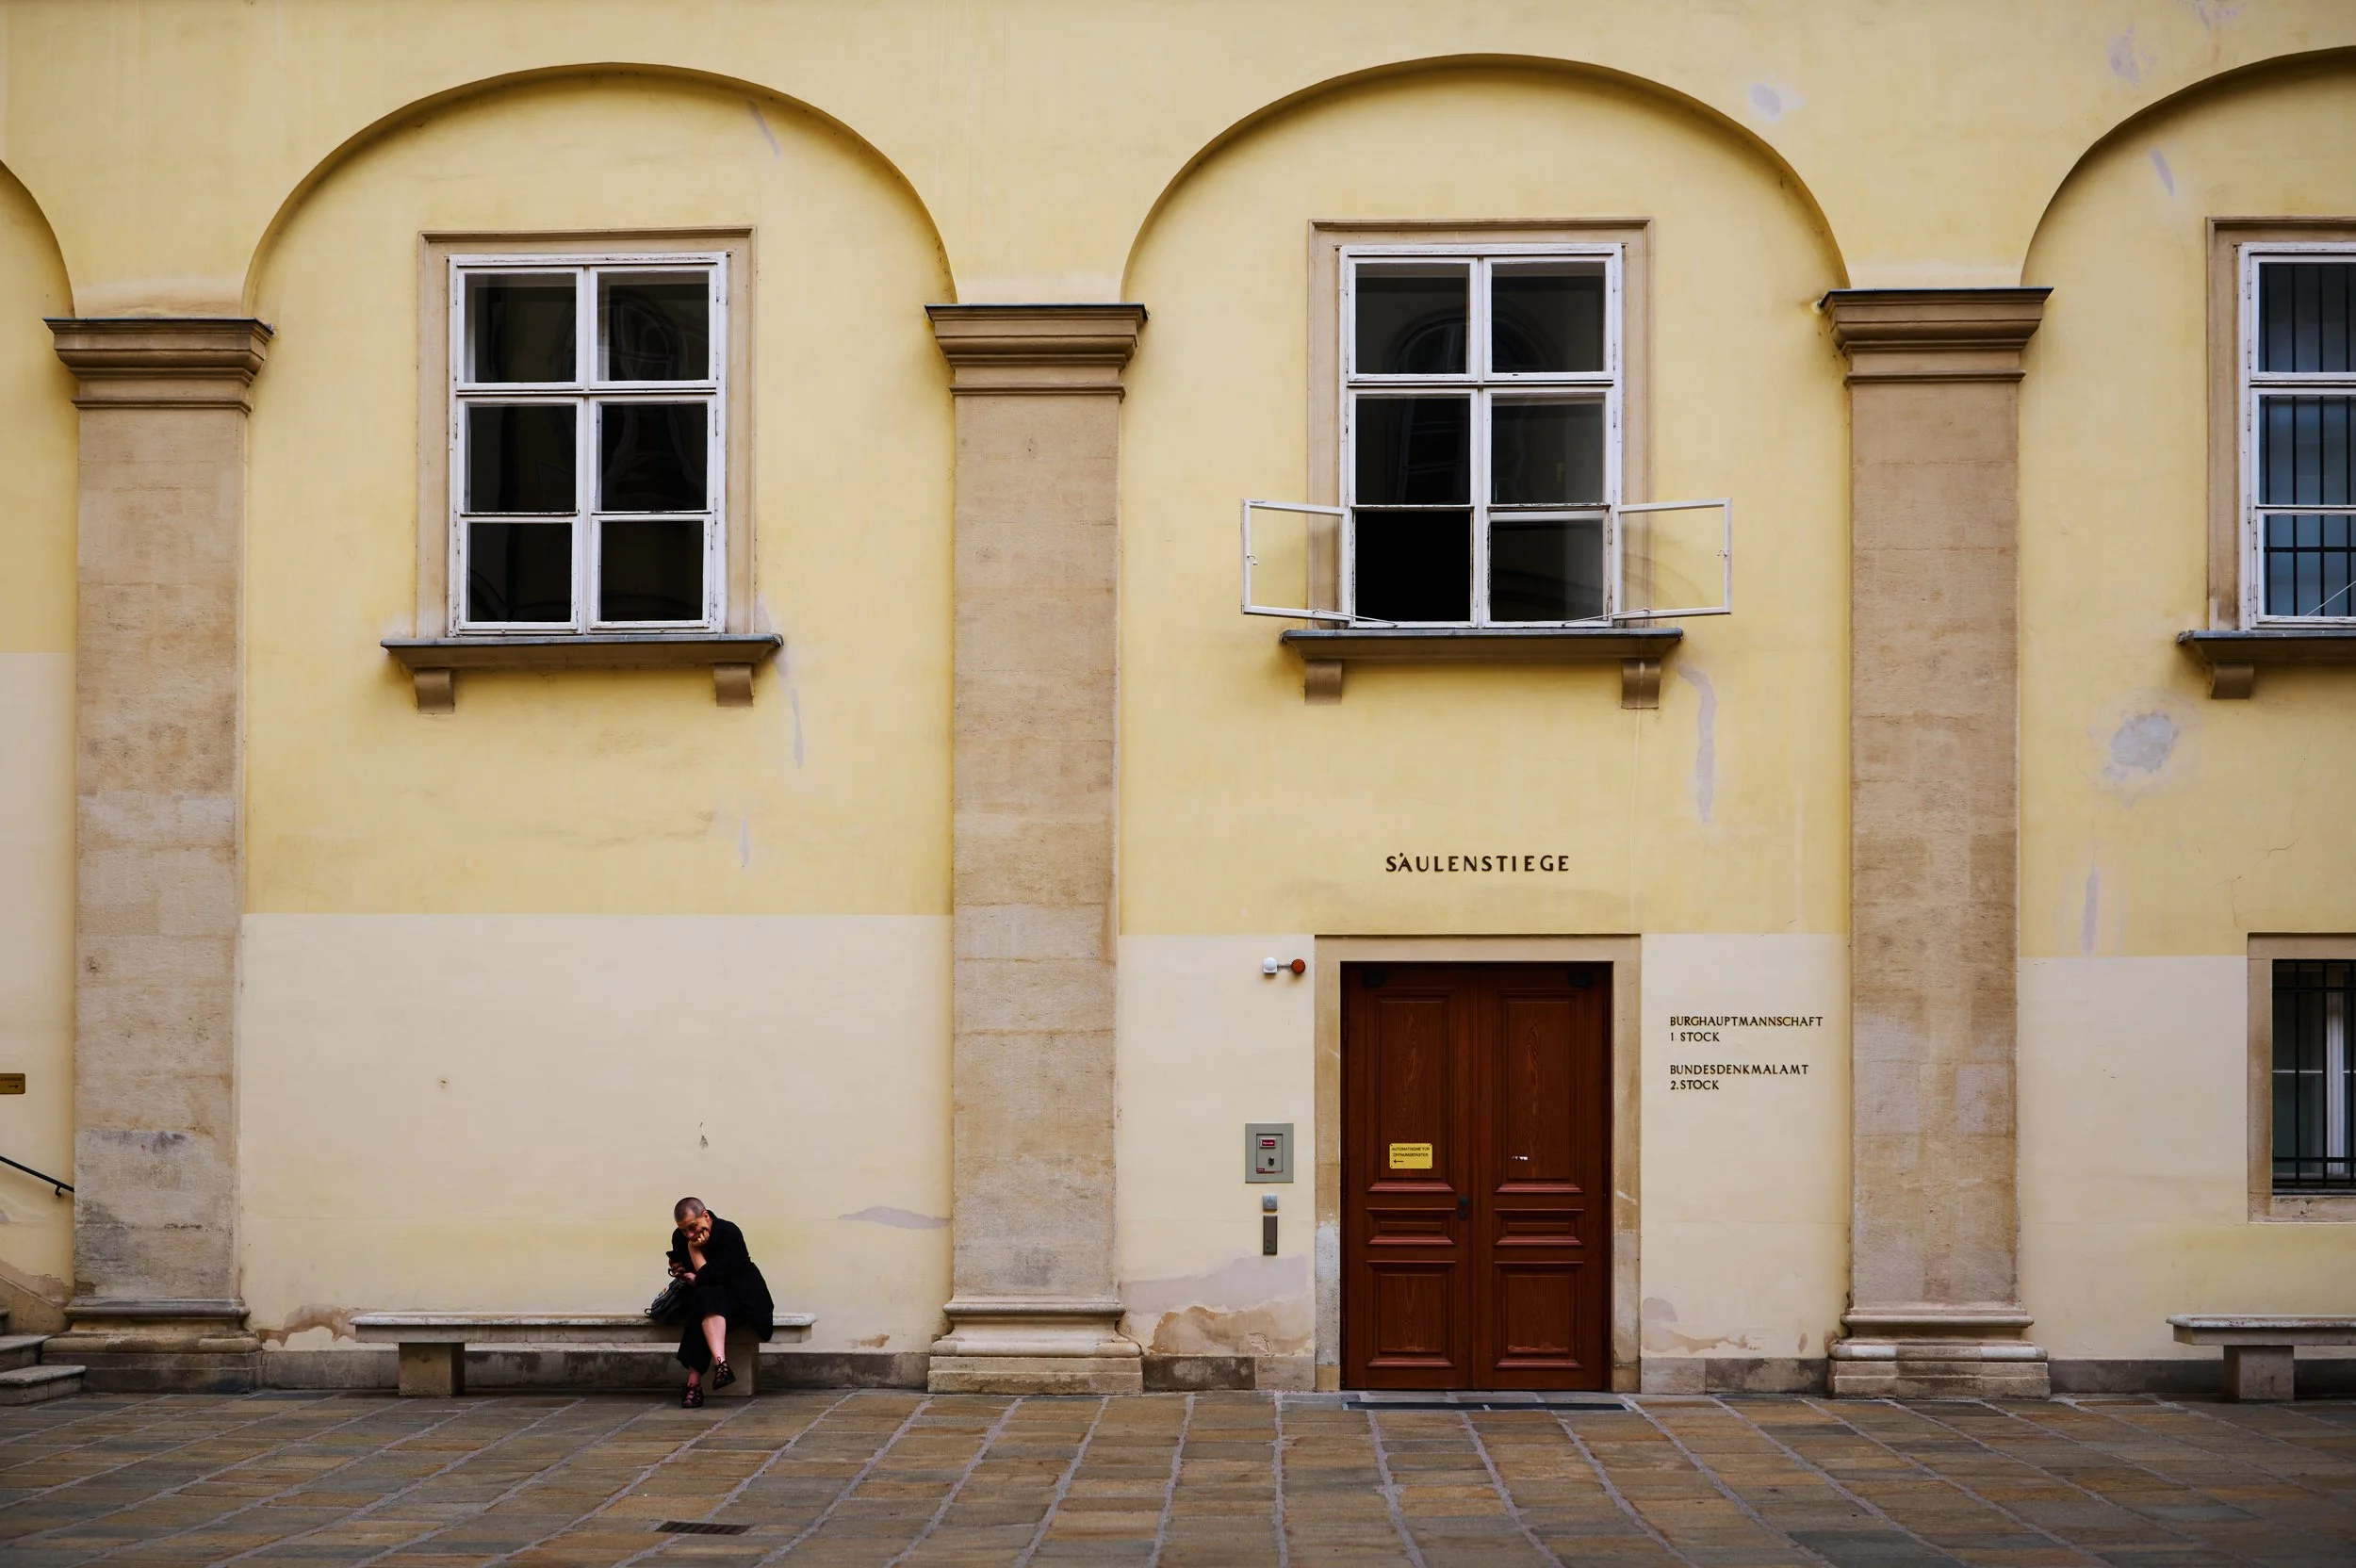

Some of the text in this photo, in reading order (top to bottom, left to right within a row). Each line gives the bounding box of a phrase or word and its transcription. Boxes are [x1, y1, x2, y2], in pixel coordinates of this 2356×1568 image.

[1670, 1016, 1824, 1027] BURGHAUPTMANNSCHAFT
[1679, 1032, 1720, 1042] STOCK
[1670, 1064, 1808, 1075] BUNDESDENKMALAMT
